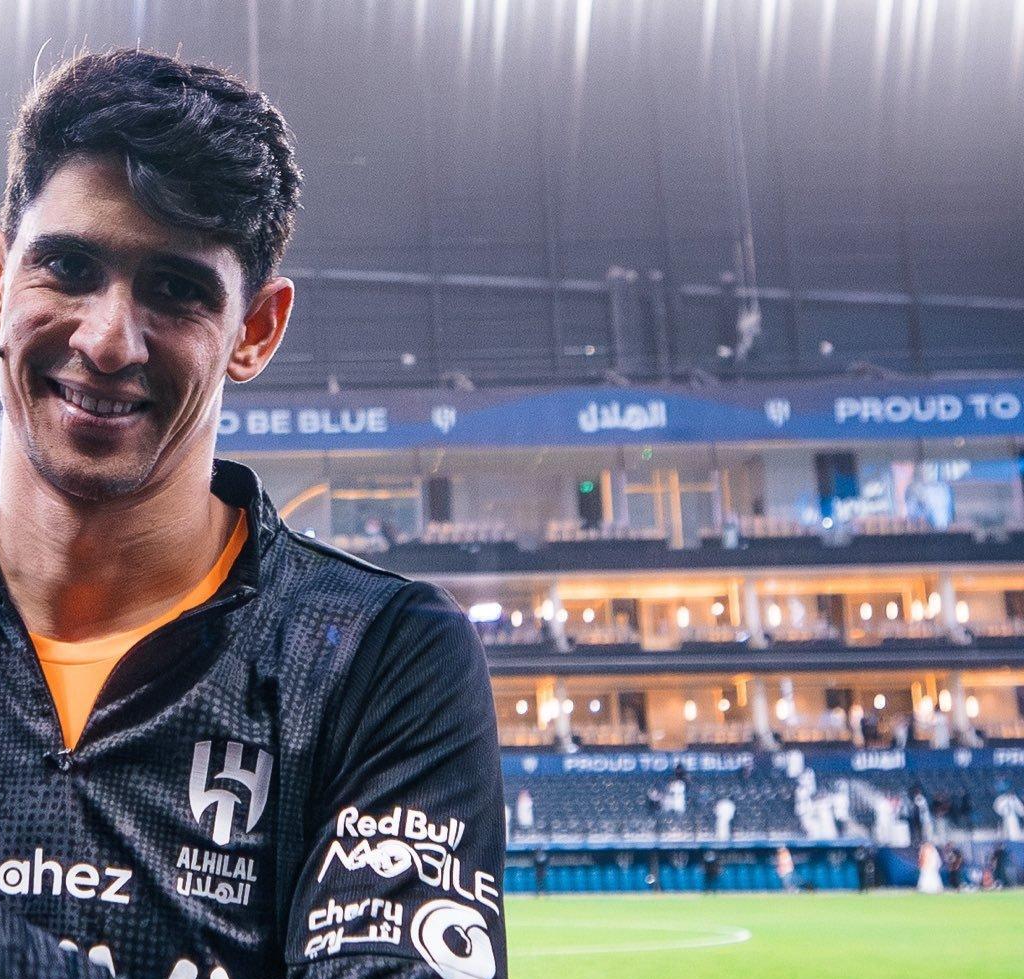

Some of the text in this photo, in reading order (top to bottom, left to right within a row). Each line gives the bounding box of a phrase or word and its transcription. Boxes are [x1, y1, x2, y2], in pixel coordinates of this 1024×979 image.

[217, 407, 388, 435] O BE BLUE
[833, 393, 1021, 424] PROUD TO
[563, 754, 637, 773] PROUD
[639, 753, 670, 772] TO
[337, 806, 466, 851] Red Bull
[176, 846, 258, 882] ALHILAL
[176, 871, 251, 906] الهلال
